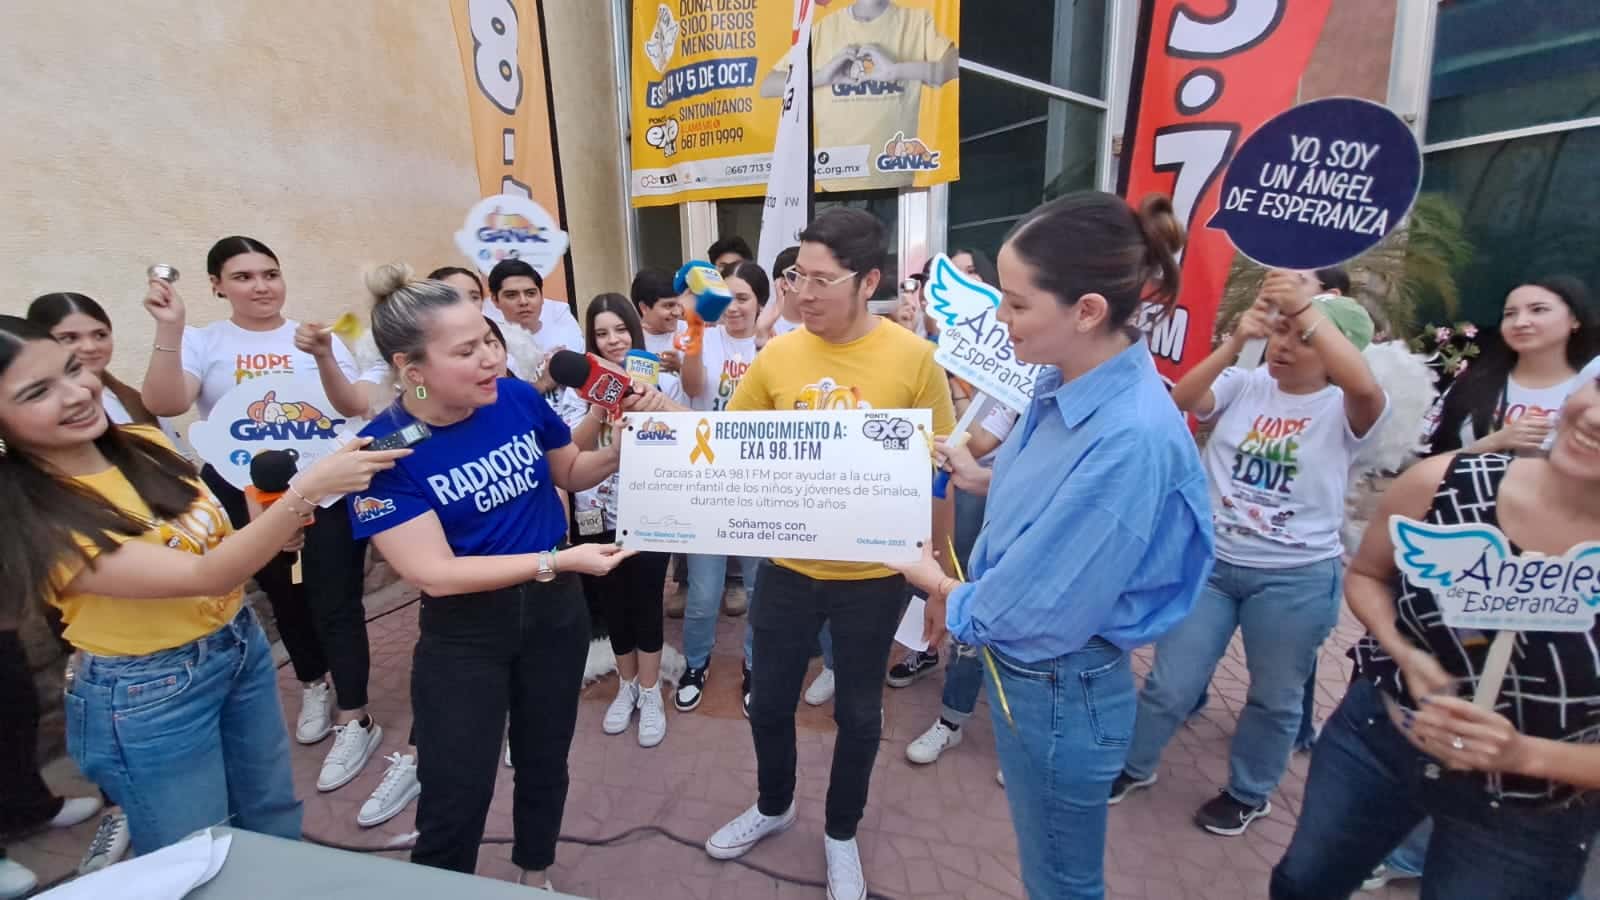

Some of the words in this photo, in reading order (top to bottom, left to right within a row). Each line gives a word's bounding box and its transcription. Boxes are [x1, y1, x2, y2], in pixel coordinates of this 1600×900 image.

[711, 12, 754, 30] PESOS
[681, 31, 756, 57] MENSUALES
[676, 71, 684, 93] Y
[687, 69, 696, 90] 5
[699, 65, 715, 88] DE
[718, 63, 753, 85] OCT.
[680, 97, 753, 121] SINTONÍZANOS
[682, 132, 697, 149] 687
[700, 129, 714, 147] 871
[717, 127, 744, 145] 9999
[877, 152, 941, 170] GANAC
[1291, 135, 1321, 163] YO
[1326, 140, 1380, 170] SOY
[814, 165, 860, 176] c.org.mx
[1259, 162, 1296, 189] UN
[1298, 160, 1374, 203] ÁNGEL
[1225, 186, 1256, 212] DE
[1258, 194, 1389, 236] ESPERANZA
[236, 354, 294, 369] HOPE
[636, 430, 677, 441] GANAC
[715, 421, 830, 440] RECONOCIMIENTO
[833, 421, 848, 440] A:
[740, 441, 765, 460] EXA
[883, 440, 909, 450] 98.1
[427, 430, 543, 506] RADIOTÓN
[654, 468, 693, 478] Gracias
[705, 468, 727, 478] EXA
[752, 469, 771, 479] FM
[773, 471, 793, 482] por
[795, 470, 836, 483] ayudar
[850, 470, 860, 481] la
[864, 472, 891, 481] cura
[1231, 452, 1298, 493] LOVE
[474, 468, 539, 512] GANAC
[629, 480, 645, 490] del
[686, 481, 724, 492] infantil
[726, 482, 741, 493] de
[743, 483, 759, 493] los
[761, 483, 793, 495] niños
[804, 483, 851, 497] jóvenes
[853, 484, 869, 496] de
[690, 495, 735, 507] durante
[737, 497, 753, 507] los
[803, 498, 815, 509] 10
[817, 499, 847, 510] años
[728, 518, 782, 530] Soñamos
[784, 522, 807, 531] con
[717, 527, 727, 538] la
[729, 530, 754, 540] cura
[757, 530, 775, 541] del
[777, 532, 818, 543] cancer
[1447, 586, 1465, 599] de
[1463, 591, 1579, 614] Esperanza
